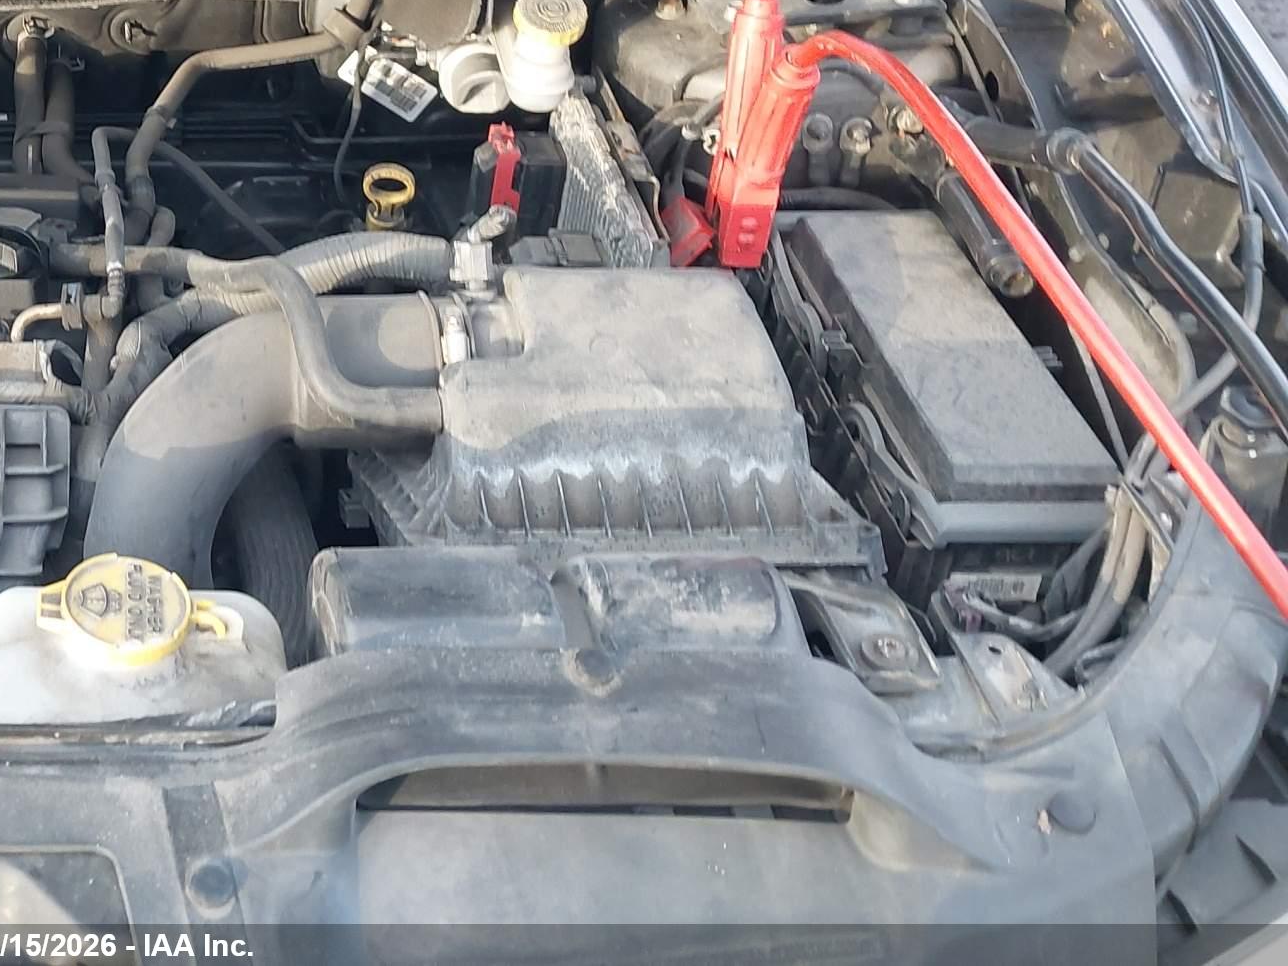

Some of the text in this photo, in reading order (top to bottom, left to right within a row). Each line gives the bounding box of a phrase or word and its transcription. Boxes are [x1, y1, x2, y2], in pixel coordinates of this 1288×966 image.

[126, 563, 144, 643] FLUID ONLY
[146, 575, 163, 634] WASHER
